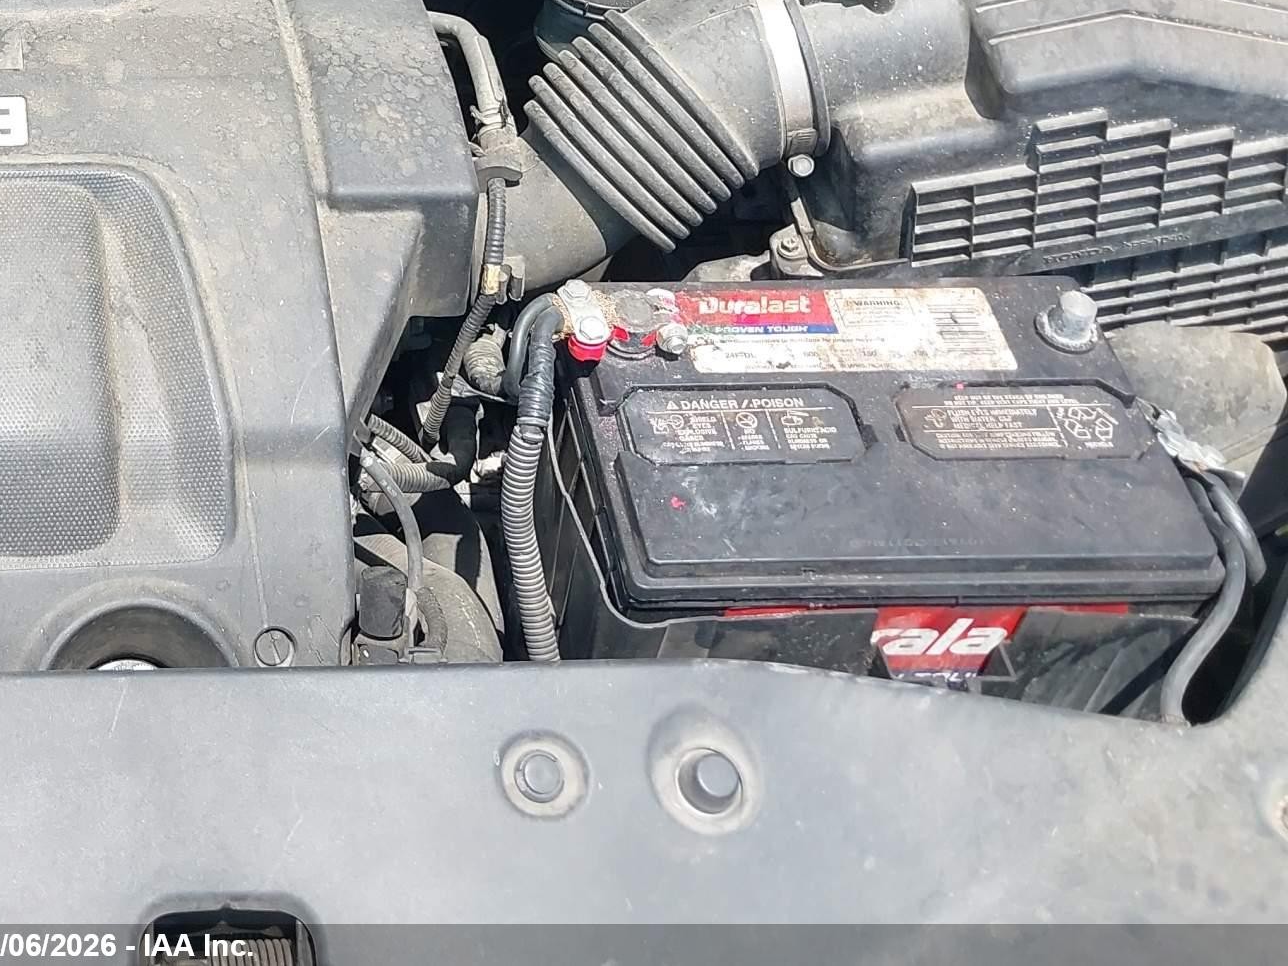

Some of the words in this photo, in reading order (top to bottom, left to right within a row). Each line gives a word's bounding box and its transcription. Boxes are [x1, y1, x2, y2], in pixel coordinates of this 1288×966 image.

[699, 295, 810, 315] Duralast
[715, 325, 763, 334] PROVEN
[765, 325, 808, 333] TOUGH
[680, 399, 738, 410] DANGER
[751, 397, 805, 409] POISON
